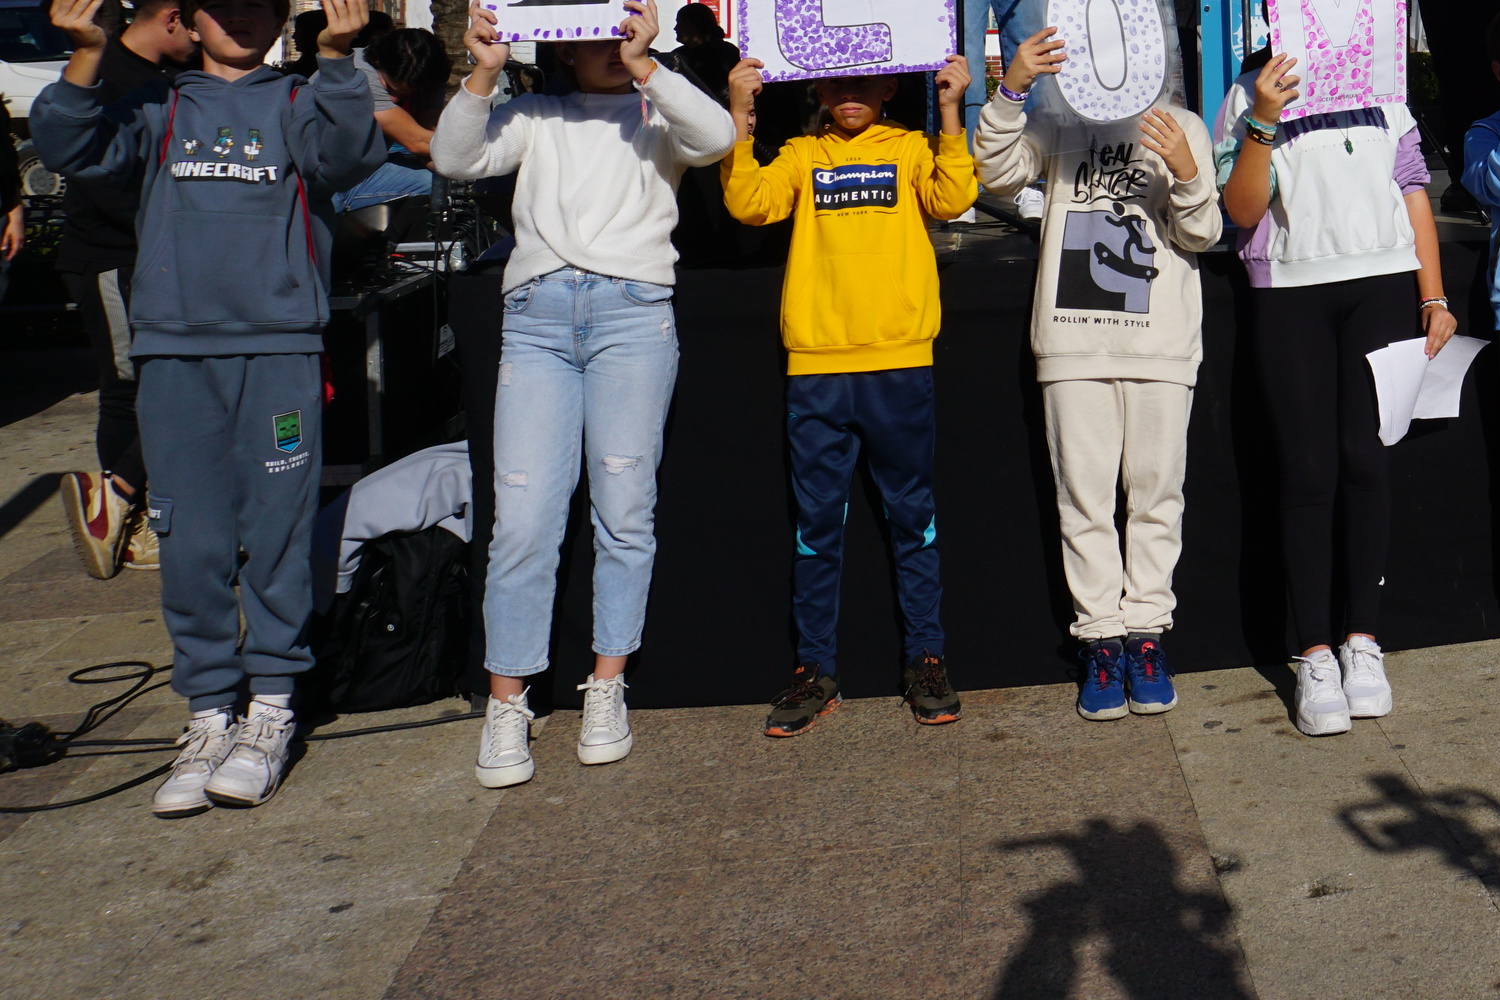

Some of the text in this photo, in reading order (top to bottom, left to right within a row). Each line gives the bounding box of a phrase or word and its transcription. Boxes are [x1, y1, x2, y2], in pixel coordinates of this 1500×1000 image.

[171, 161, 278, 182] MINECRAFT
[816, 170, 894, 184] Champion
[815, 190, 892, 204] AUTHENTIC
[1053, 315, 1150, 328] ROLLIN' WITH STYLE
